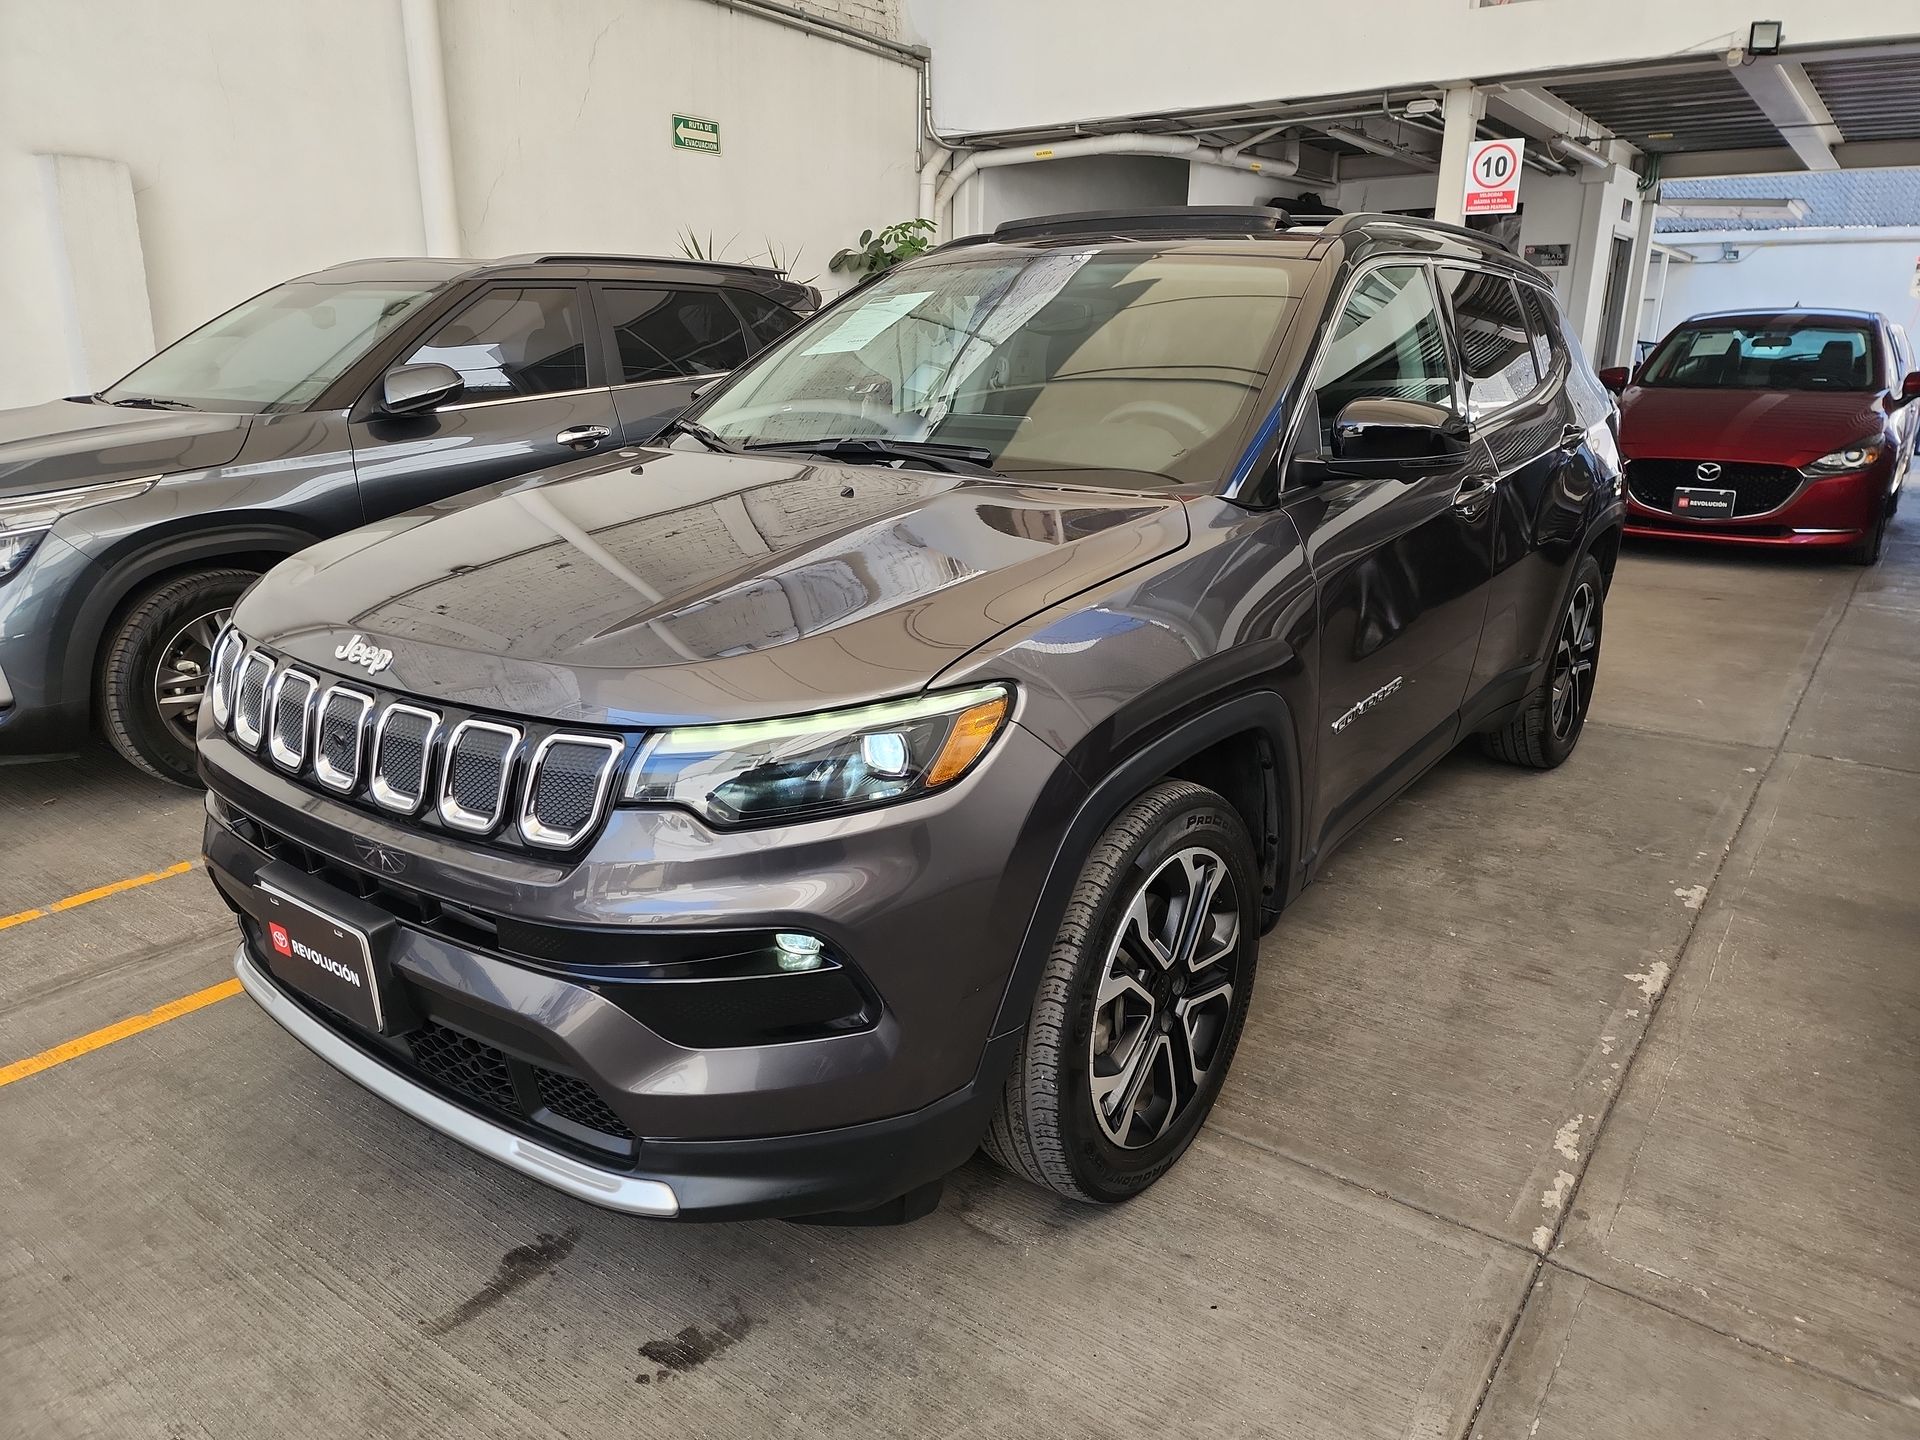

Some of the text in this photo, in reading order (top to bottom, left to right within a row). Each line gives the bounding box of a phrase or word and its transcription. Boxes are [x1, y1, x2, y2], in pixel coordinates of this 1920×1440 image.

[688, 120, 713, 132] RUTA DE
[1482, 155, 1508, 178] 10
[334, 634, 394, 676] Jeep
[291, 939, 361, 988] REVOLUCIÓN
